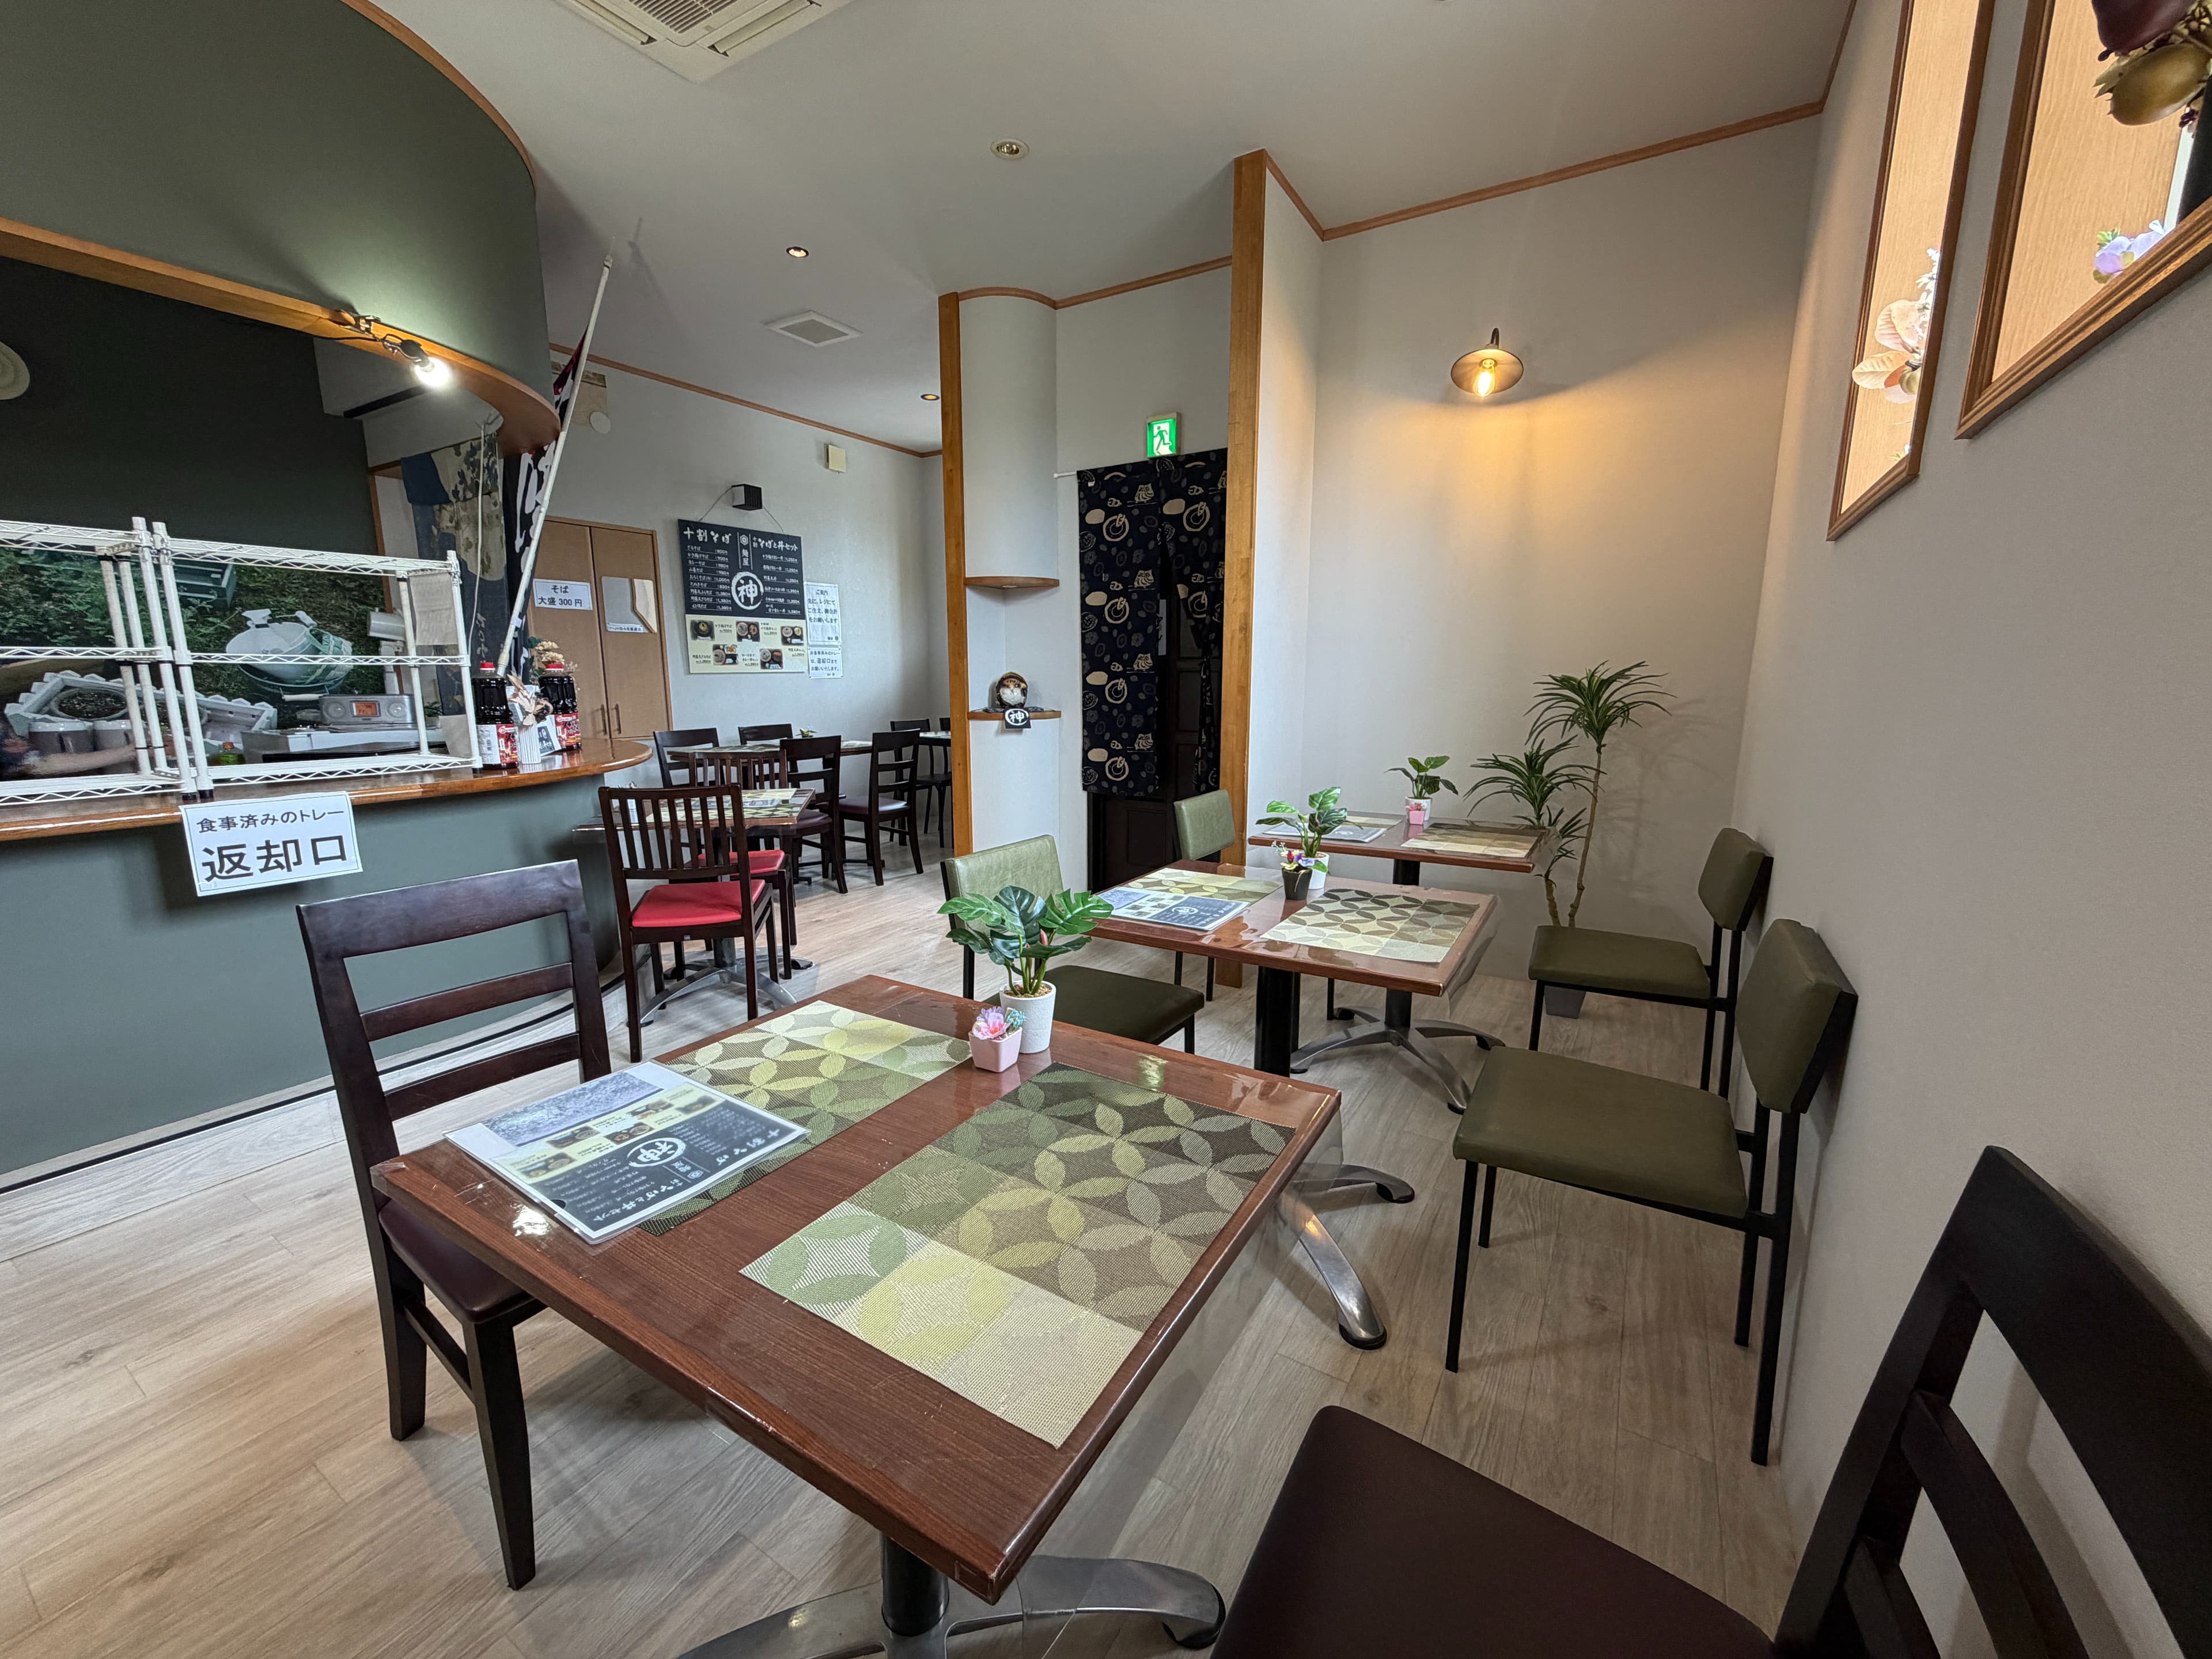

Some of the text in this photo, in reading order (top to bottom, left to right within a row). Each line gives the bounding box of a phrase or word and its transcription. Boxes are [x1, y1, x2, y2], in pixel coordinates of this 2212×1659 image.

[683, 527, 732, 544] 十割そば
[737, 579, 758, 605] 神
[1009, 711, 1025, 724] 神
[196, 809, 344, 834] 食事済みのトレー
[201, 835, 347, 882] 返却口
